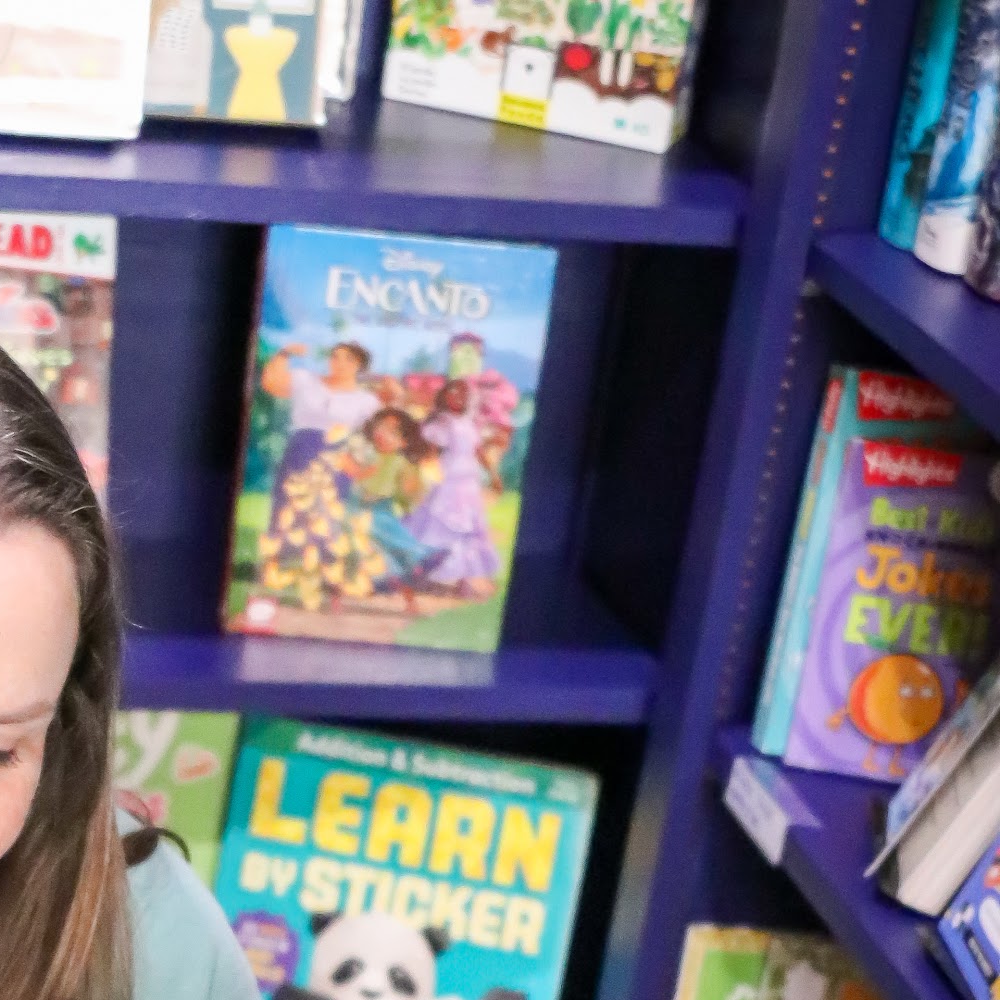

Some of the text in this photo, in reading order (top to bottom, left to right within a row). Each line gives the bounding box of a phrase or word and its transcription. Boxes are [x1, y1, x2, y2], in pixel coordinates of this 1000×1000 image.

[326, 264, 491, 320] ENCANTO
[250, 758, 562, 892] LEARN
[239, 852, 297, 896] BY
[302, 857, 546, 956] STICKER
